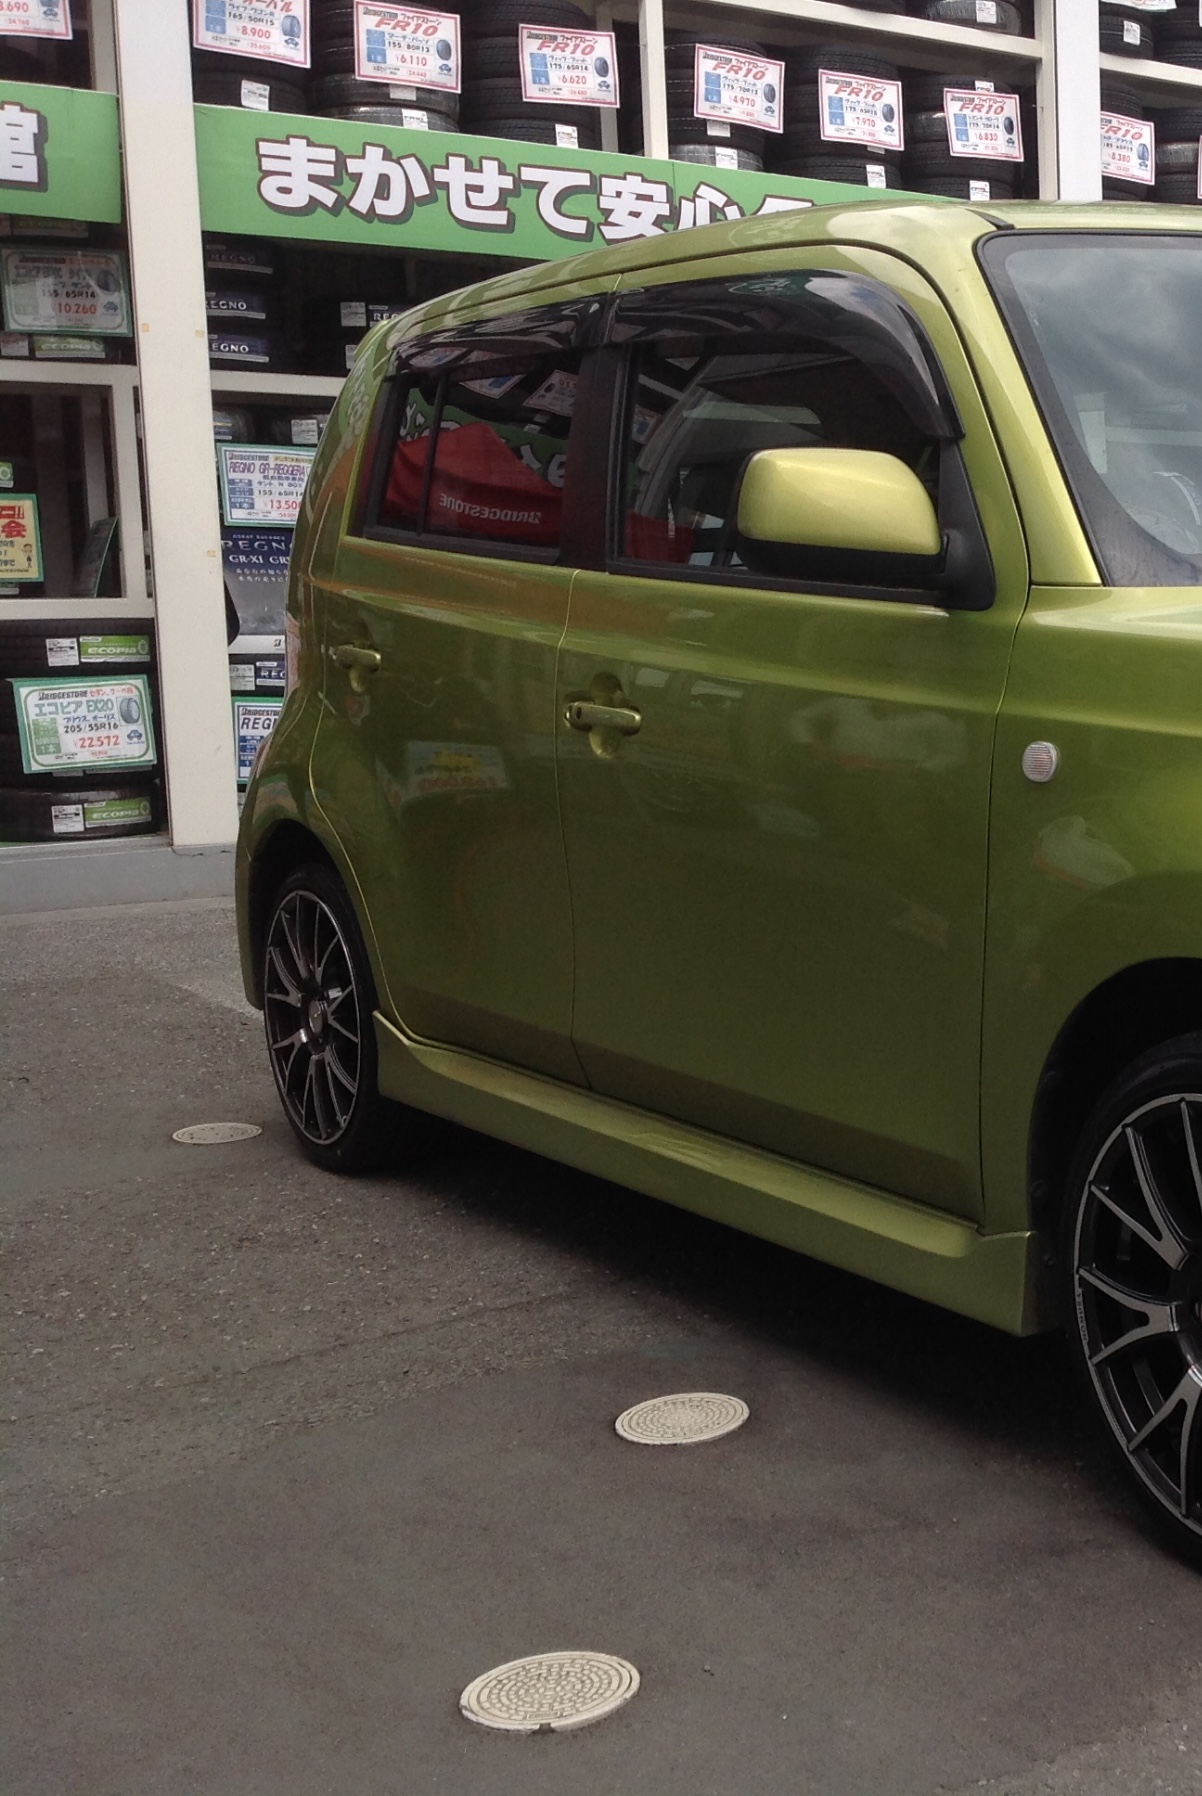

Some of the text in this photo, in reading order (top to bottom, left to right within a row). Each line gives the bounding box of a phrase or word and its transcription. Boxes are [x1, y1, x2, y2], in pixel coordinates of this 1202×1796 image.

[374, 18, 438, 36] FR10
[537, 40, 595, 56] FR10
[711, 61, 766, 80] FR10
[834, 85, 884, 101] FR10
[959, 102, 1004, 115] FR10
[257, 136, 812, 243] まかせて安心
[57, 302, 97, 315] 10.260
[206, 301, 247, 310] EGNO
[229, 462, 256, 474] REGNO
[38, 690, 88, 701] BRIDGESTONE
[86, 698, 114, 713] EX20
[64, 722, 119, 734] 205/55R16
